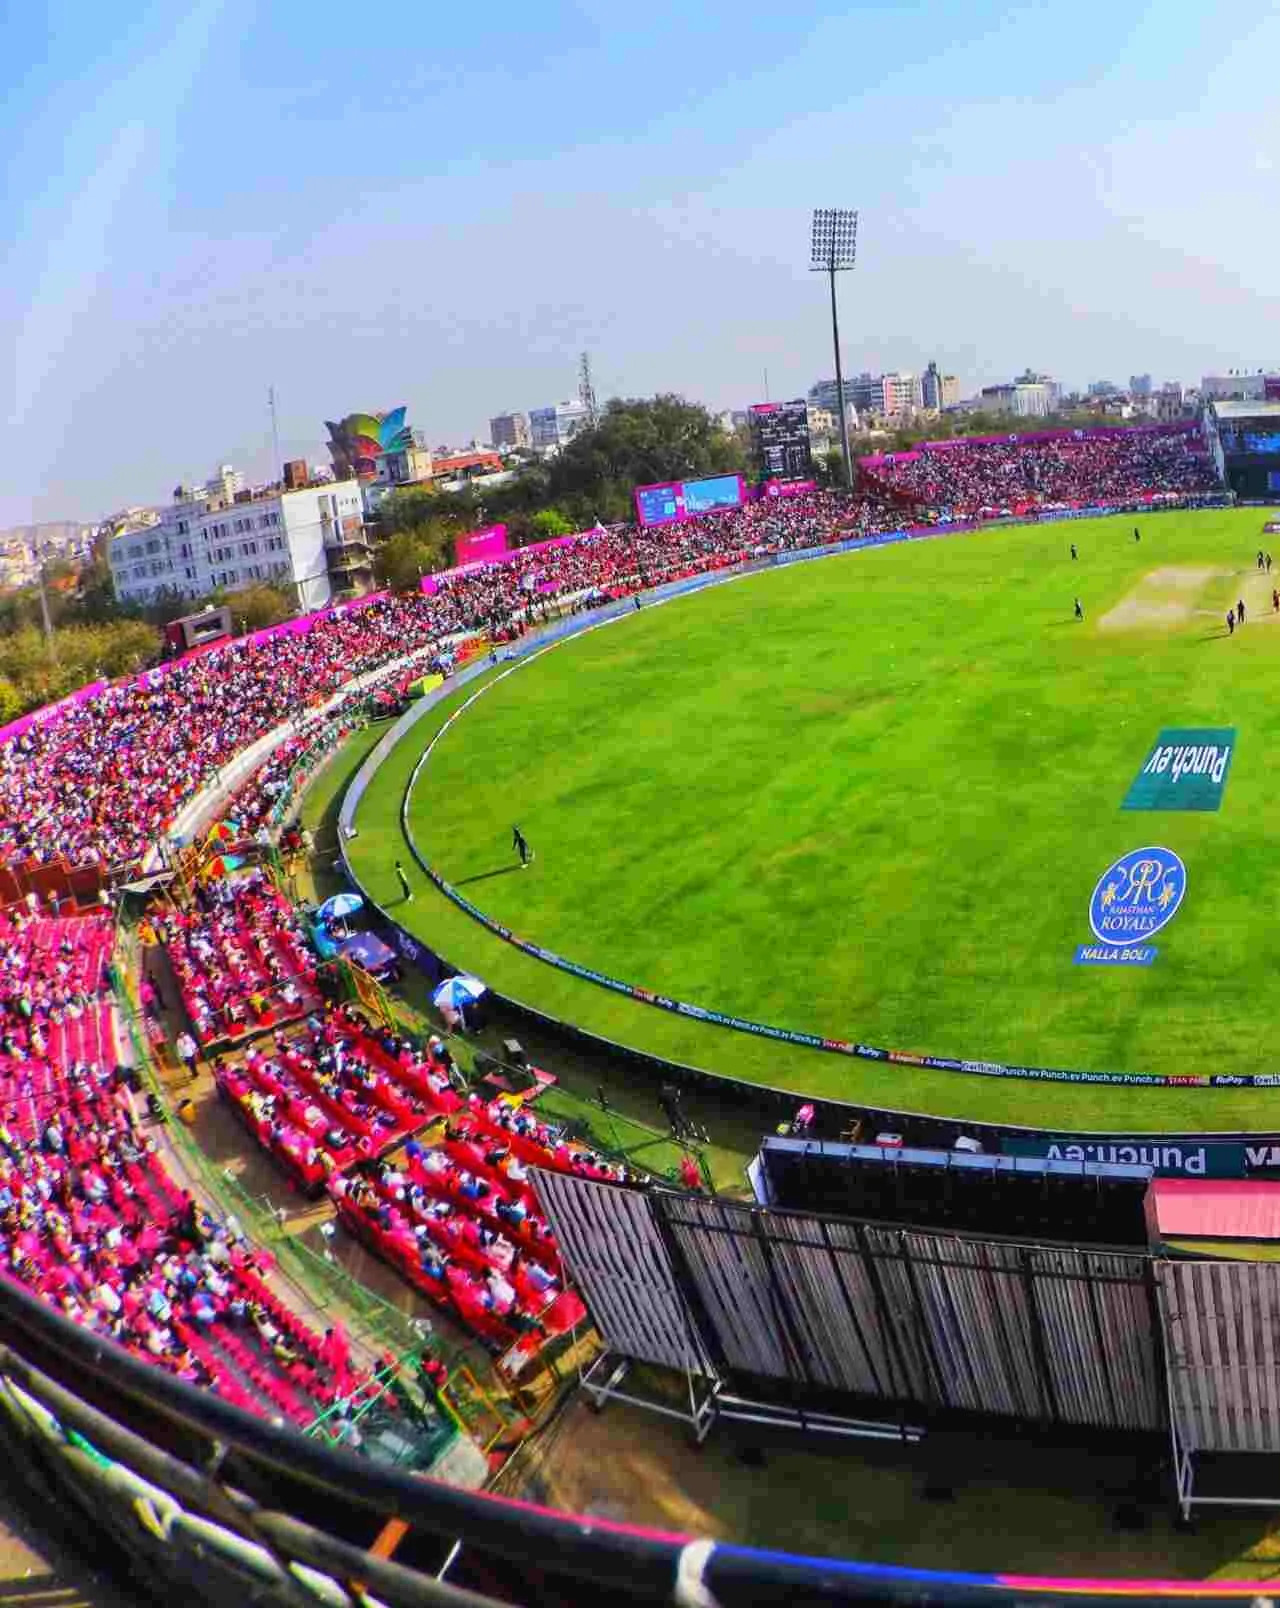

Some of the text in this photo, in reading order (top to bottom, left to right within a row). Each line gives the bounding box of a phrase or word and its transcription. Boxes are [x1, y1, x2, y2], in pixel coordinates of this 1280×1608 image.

[1144, 743, 1230, 784] Punch.ev
[1101, 914, 1157, 931] ROYALS
[1040, 1069, 1081, 1081] Punch.ev
[1082, 1073, 1122, 1083] Punch.ev
[1124, 1074, 1166, 1084] Punch.ev
